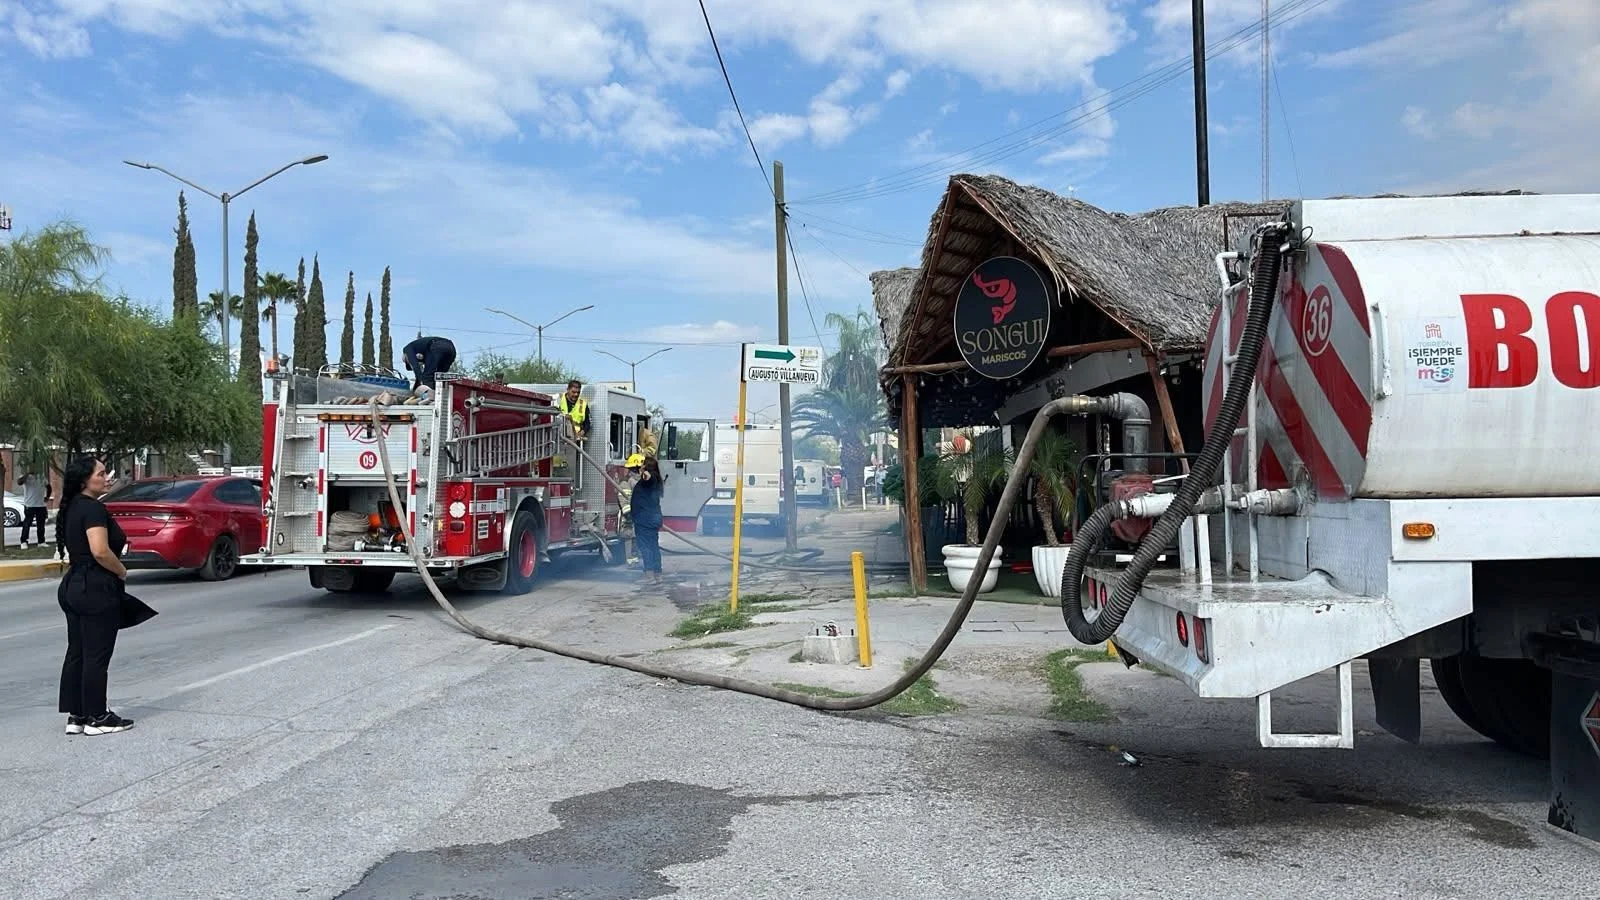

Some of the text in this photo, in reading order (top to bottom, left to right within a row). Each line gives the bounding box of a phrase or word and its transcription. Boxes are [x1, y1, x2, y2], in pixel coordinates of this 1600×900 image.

[1307, 295, 1330, 342] 36
[962, 318, 1044, 355] SONGUI
[1459, 291, 1600, 389] BO
[981, 350, 1027, 365] MARISCOS
[1408, 347, 1463, 358] ¡SIEMPRE
[1416, 357, 1456, 366] PUEDE
[751, 369, 815, 381] AUGUSTO VILLANUEVA
[363, 454, 374, 467] 09
